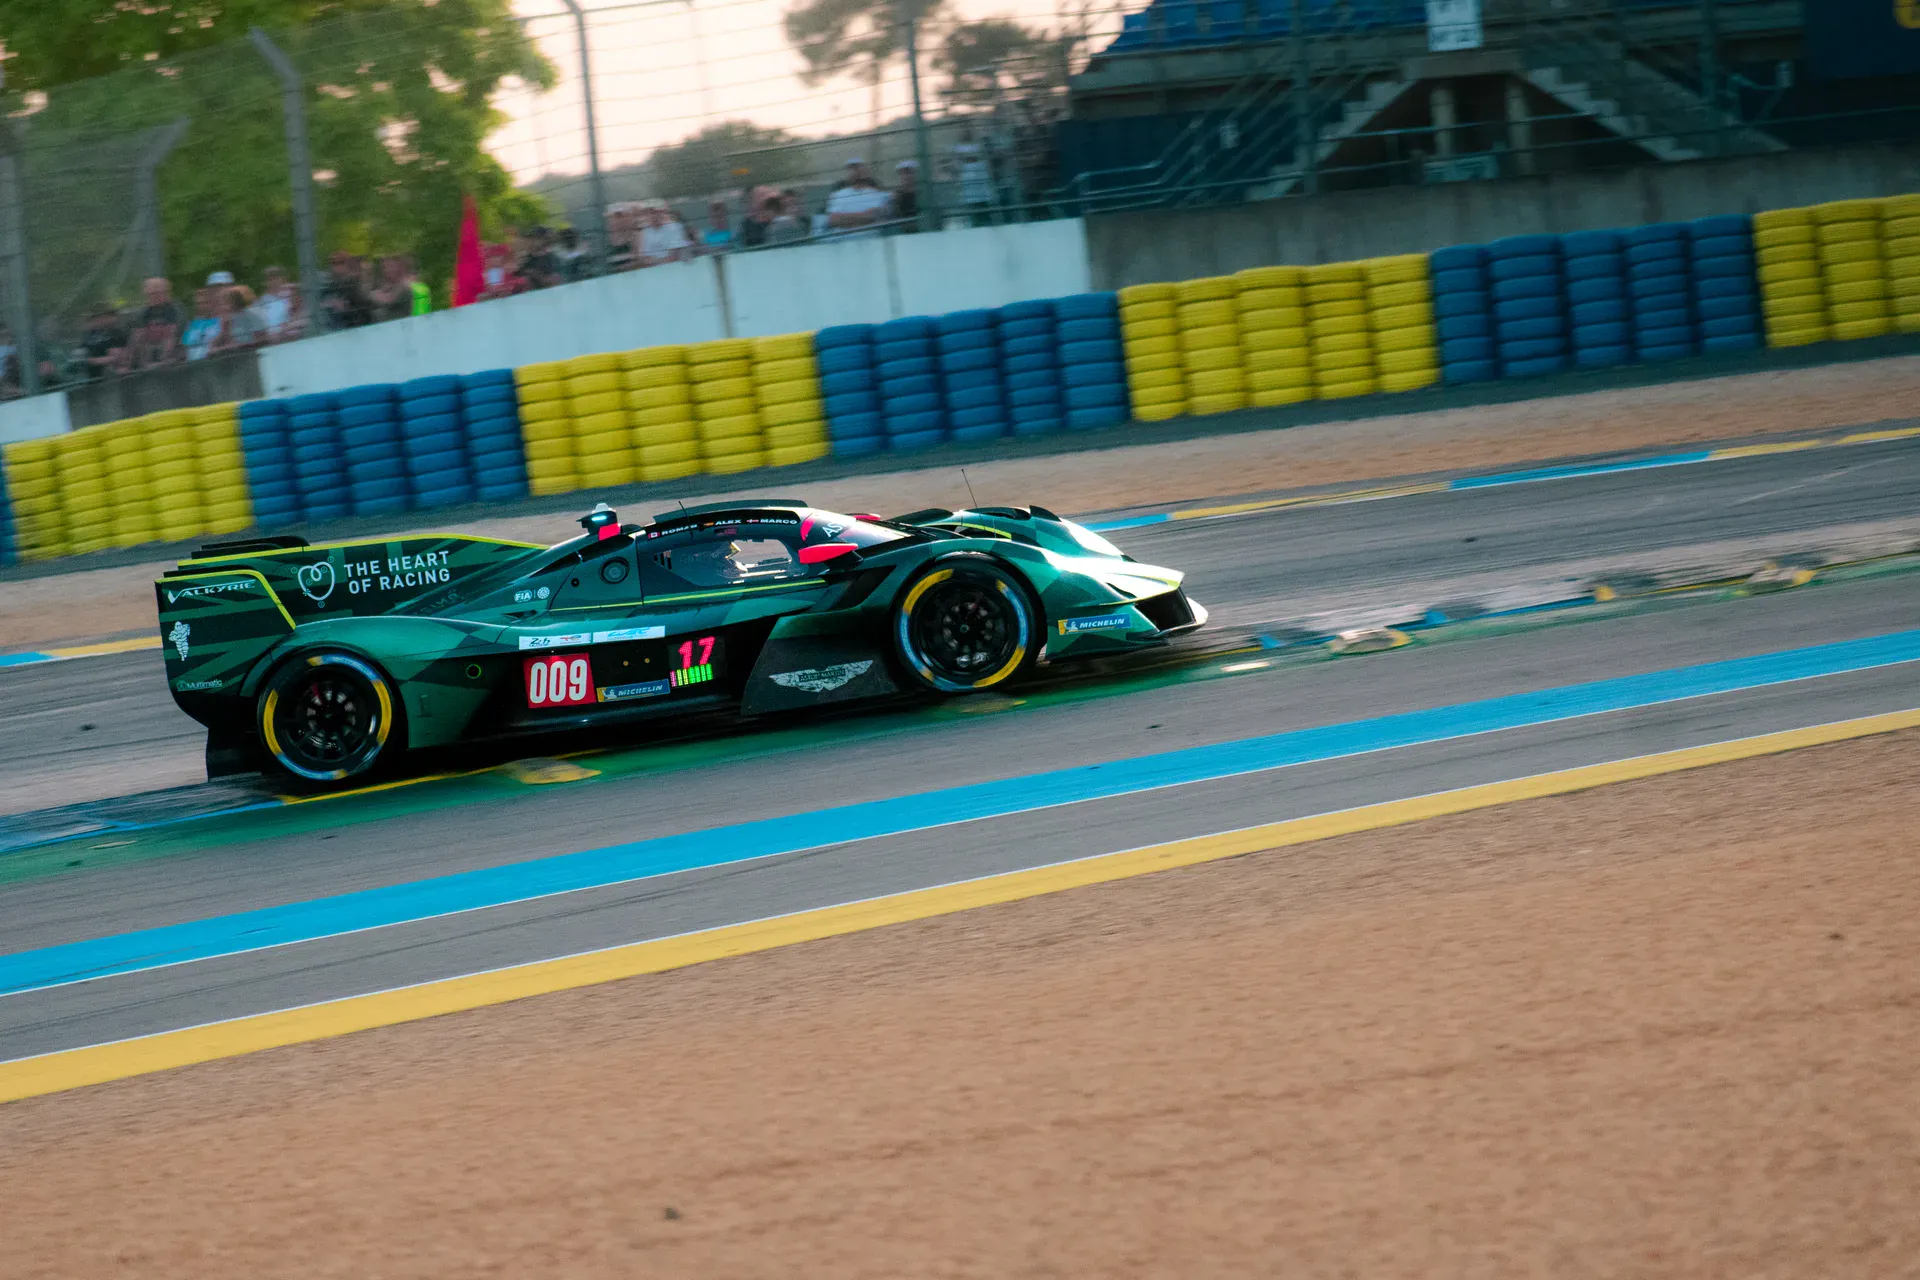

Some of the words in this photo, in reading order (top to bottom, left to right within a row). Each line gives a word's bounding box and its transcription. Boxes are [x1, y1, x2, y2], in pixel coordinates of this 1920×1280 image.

[343, 560, 381, 578] THE
[387, 550, 449, 572] HEART
[167, 579, 256, 604] VALKYRIE
[348, 578, 372, 594] OF
[379, 568, 451, 591] RACING
[515, 591, 532, 601] FIA
[1079, 618, 1125, 629] MICHELIN
[678, 636, 716, 669] 17
[530, 659, 588, 704] 009
[617, 684, 663, 696] MICHELIN
